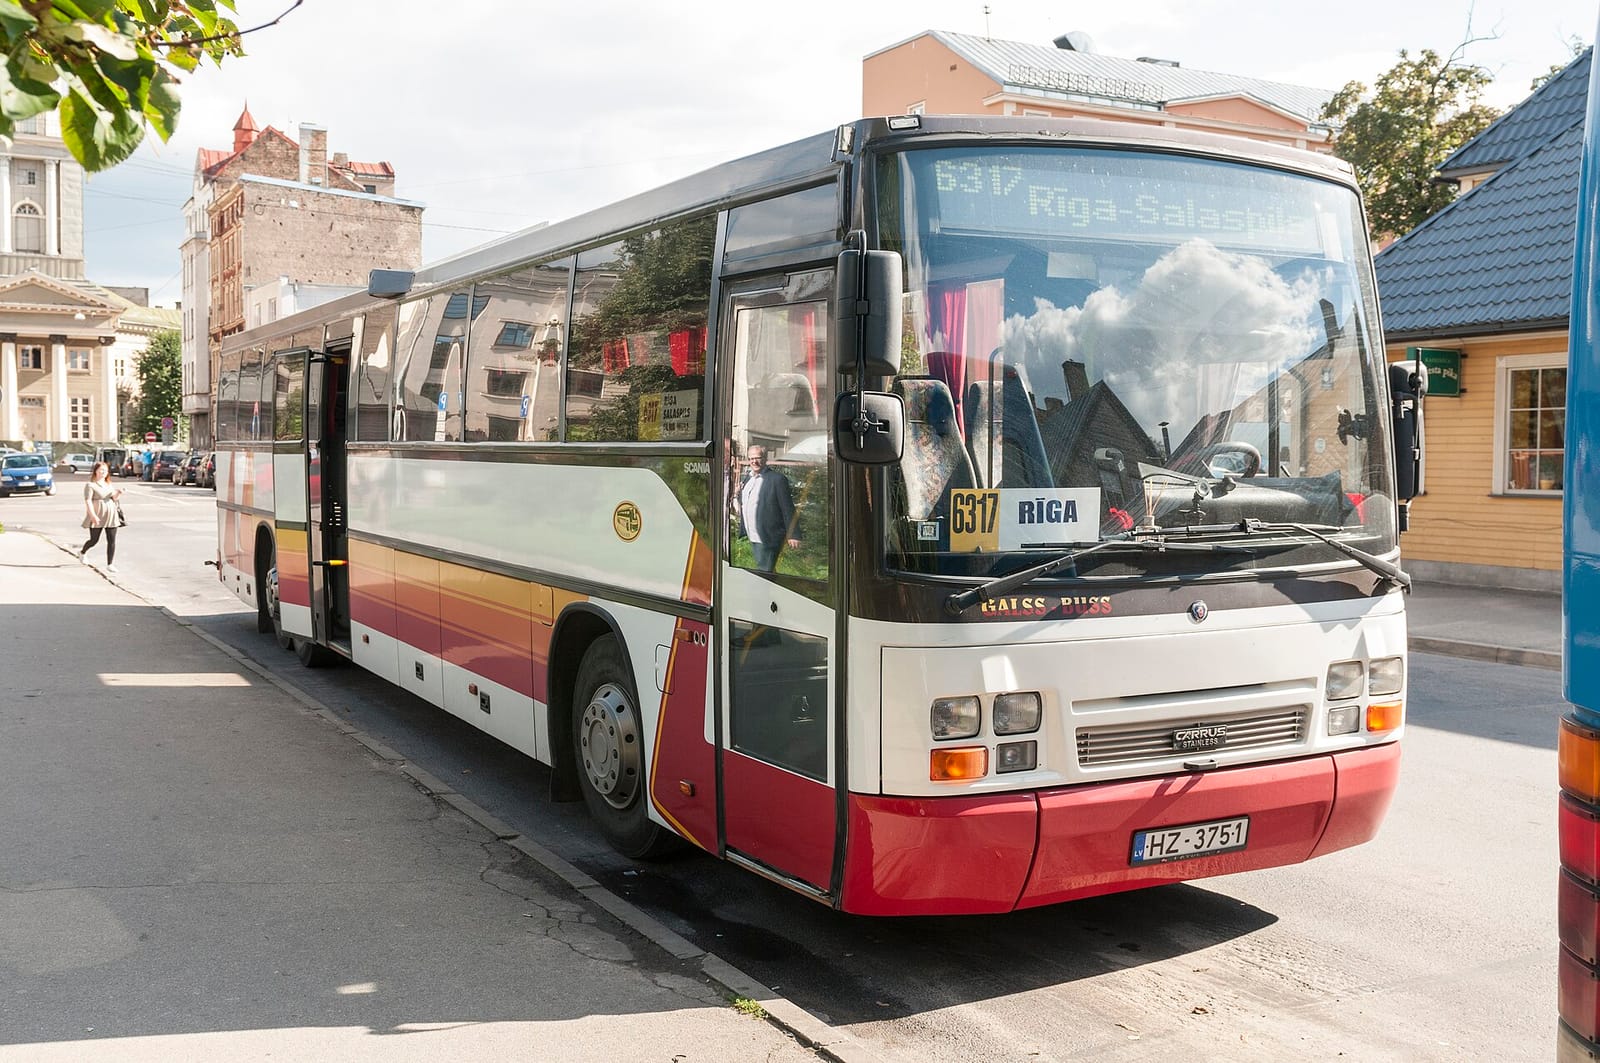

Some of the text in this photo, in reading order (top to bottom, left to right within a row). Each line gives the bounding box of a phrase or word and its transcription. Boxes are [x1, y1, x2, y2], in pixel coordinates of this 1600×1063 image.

[934, 159, 1022, 196] 6317
[683, 462, 711, 474] SCANIA
[951, 492, 1079, 535] 6317 RĪGA
[1060, 595, 1113, 616] BUSS
[1175, 726, 1226, 741] CARRUS
[1182, 737, 1219, 749] STAINLESS
[1134, 849, 1144, 858] LV
